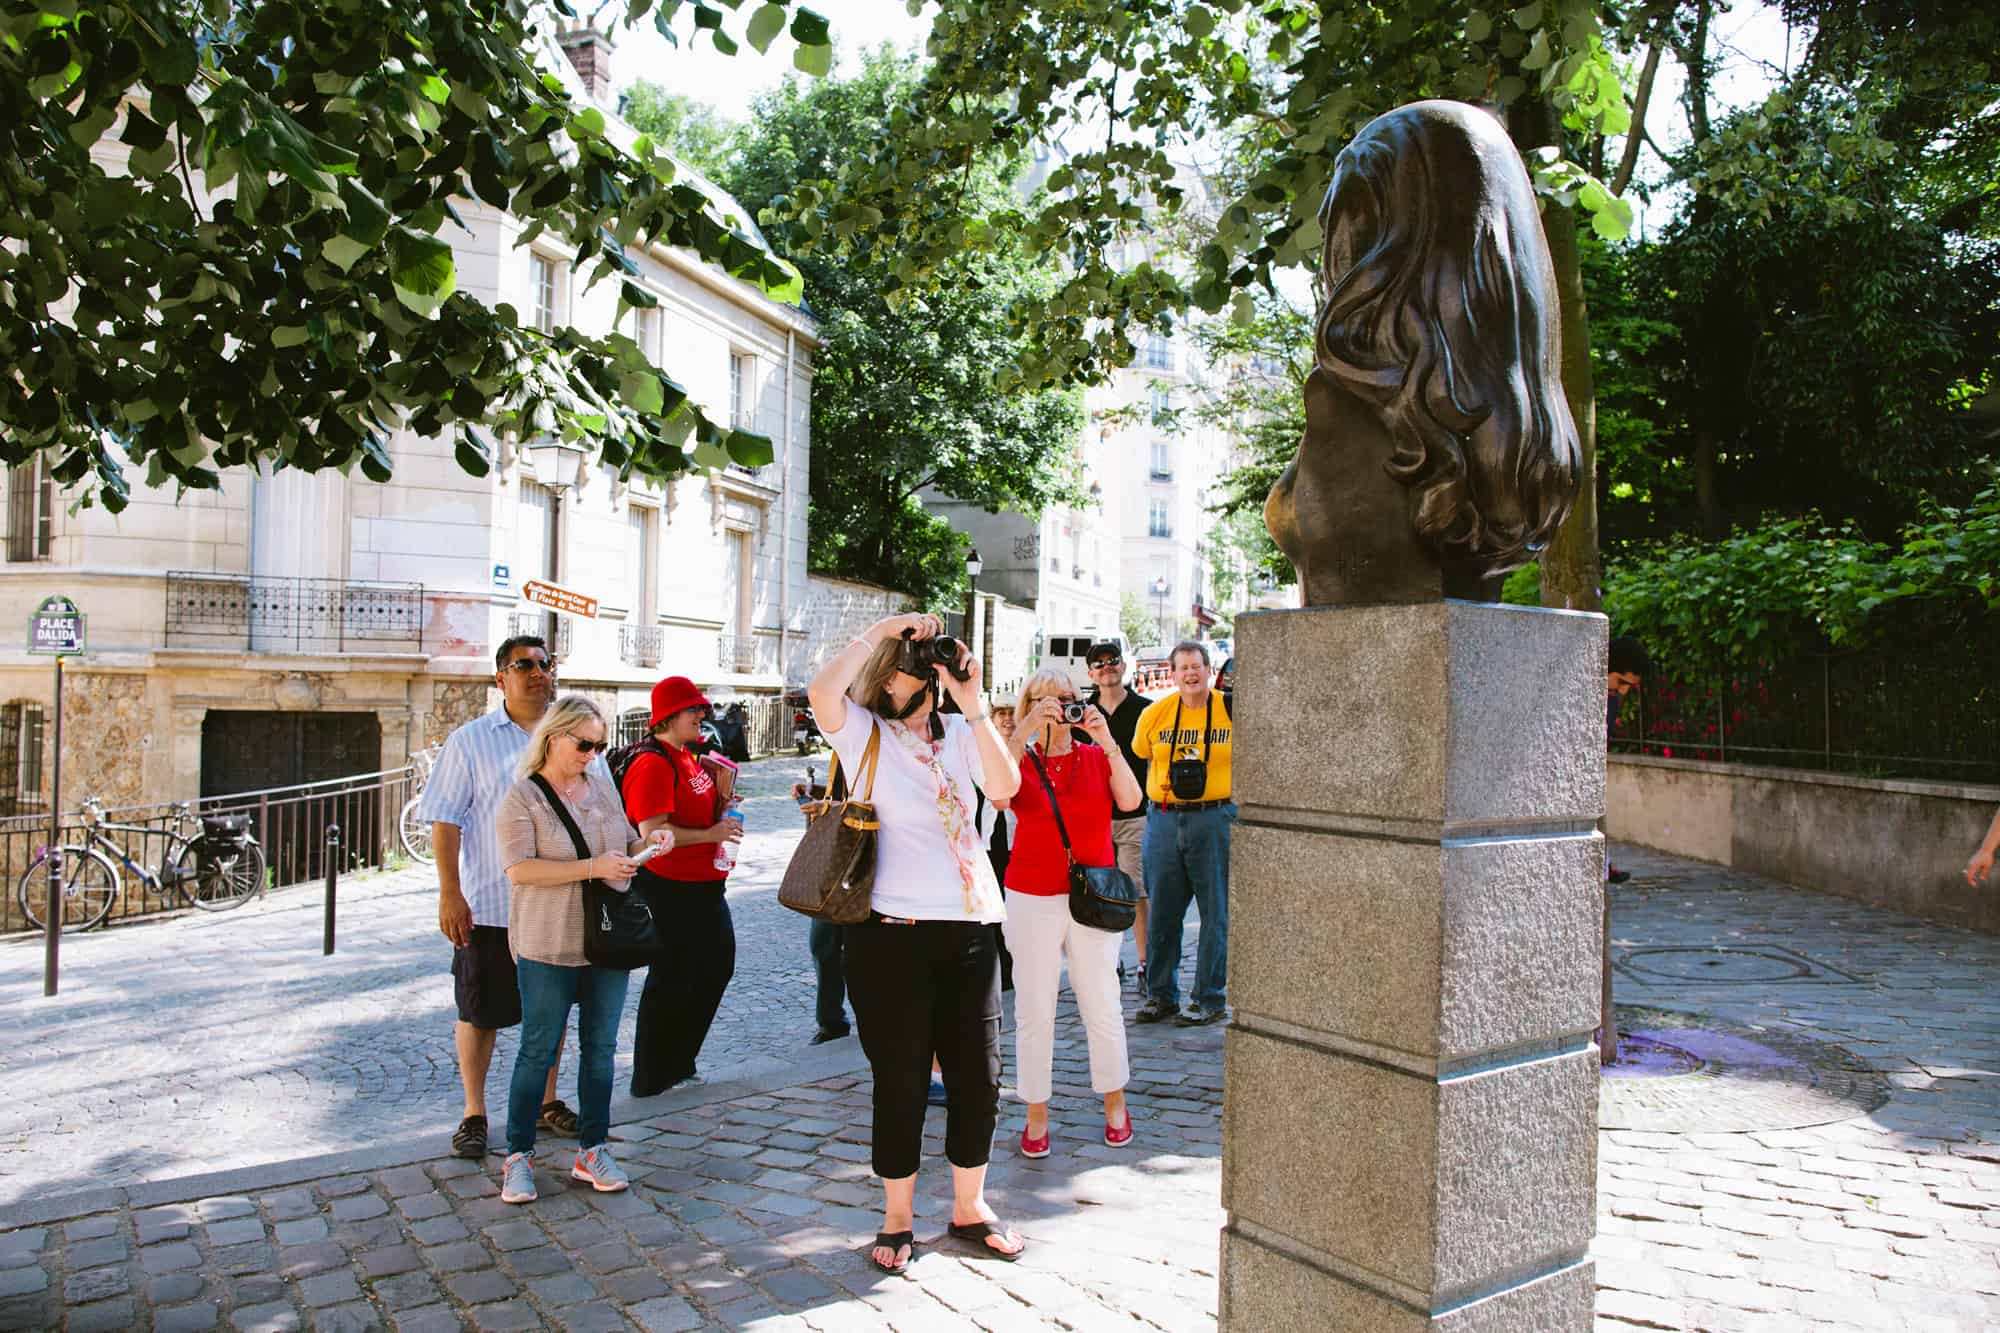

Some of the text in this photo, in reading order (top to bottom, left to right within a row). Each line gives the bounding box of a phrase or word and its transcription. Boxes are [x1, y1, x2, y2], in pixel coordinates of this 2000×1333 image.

[40, 618, 75, 629] PLACE
[37, 629, 76, 641] DALIDA
[1159, 728, 1230, 745] MIZOU-AH!
